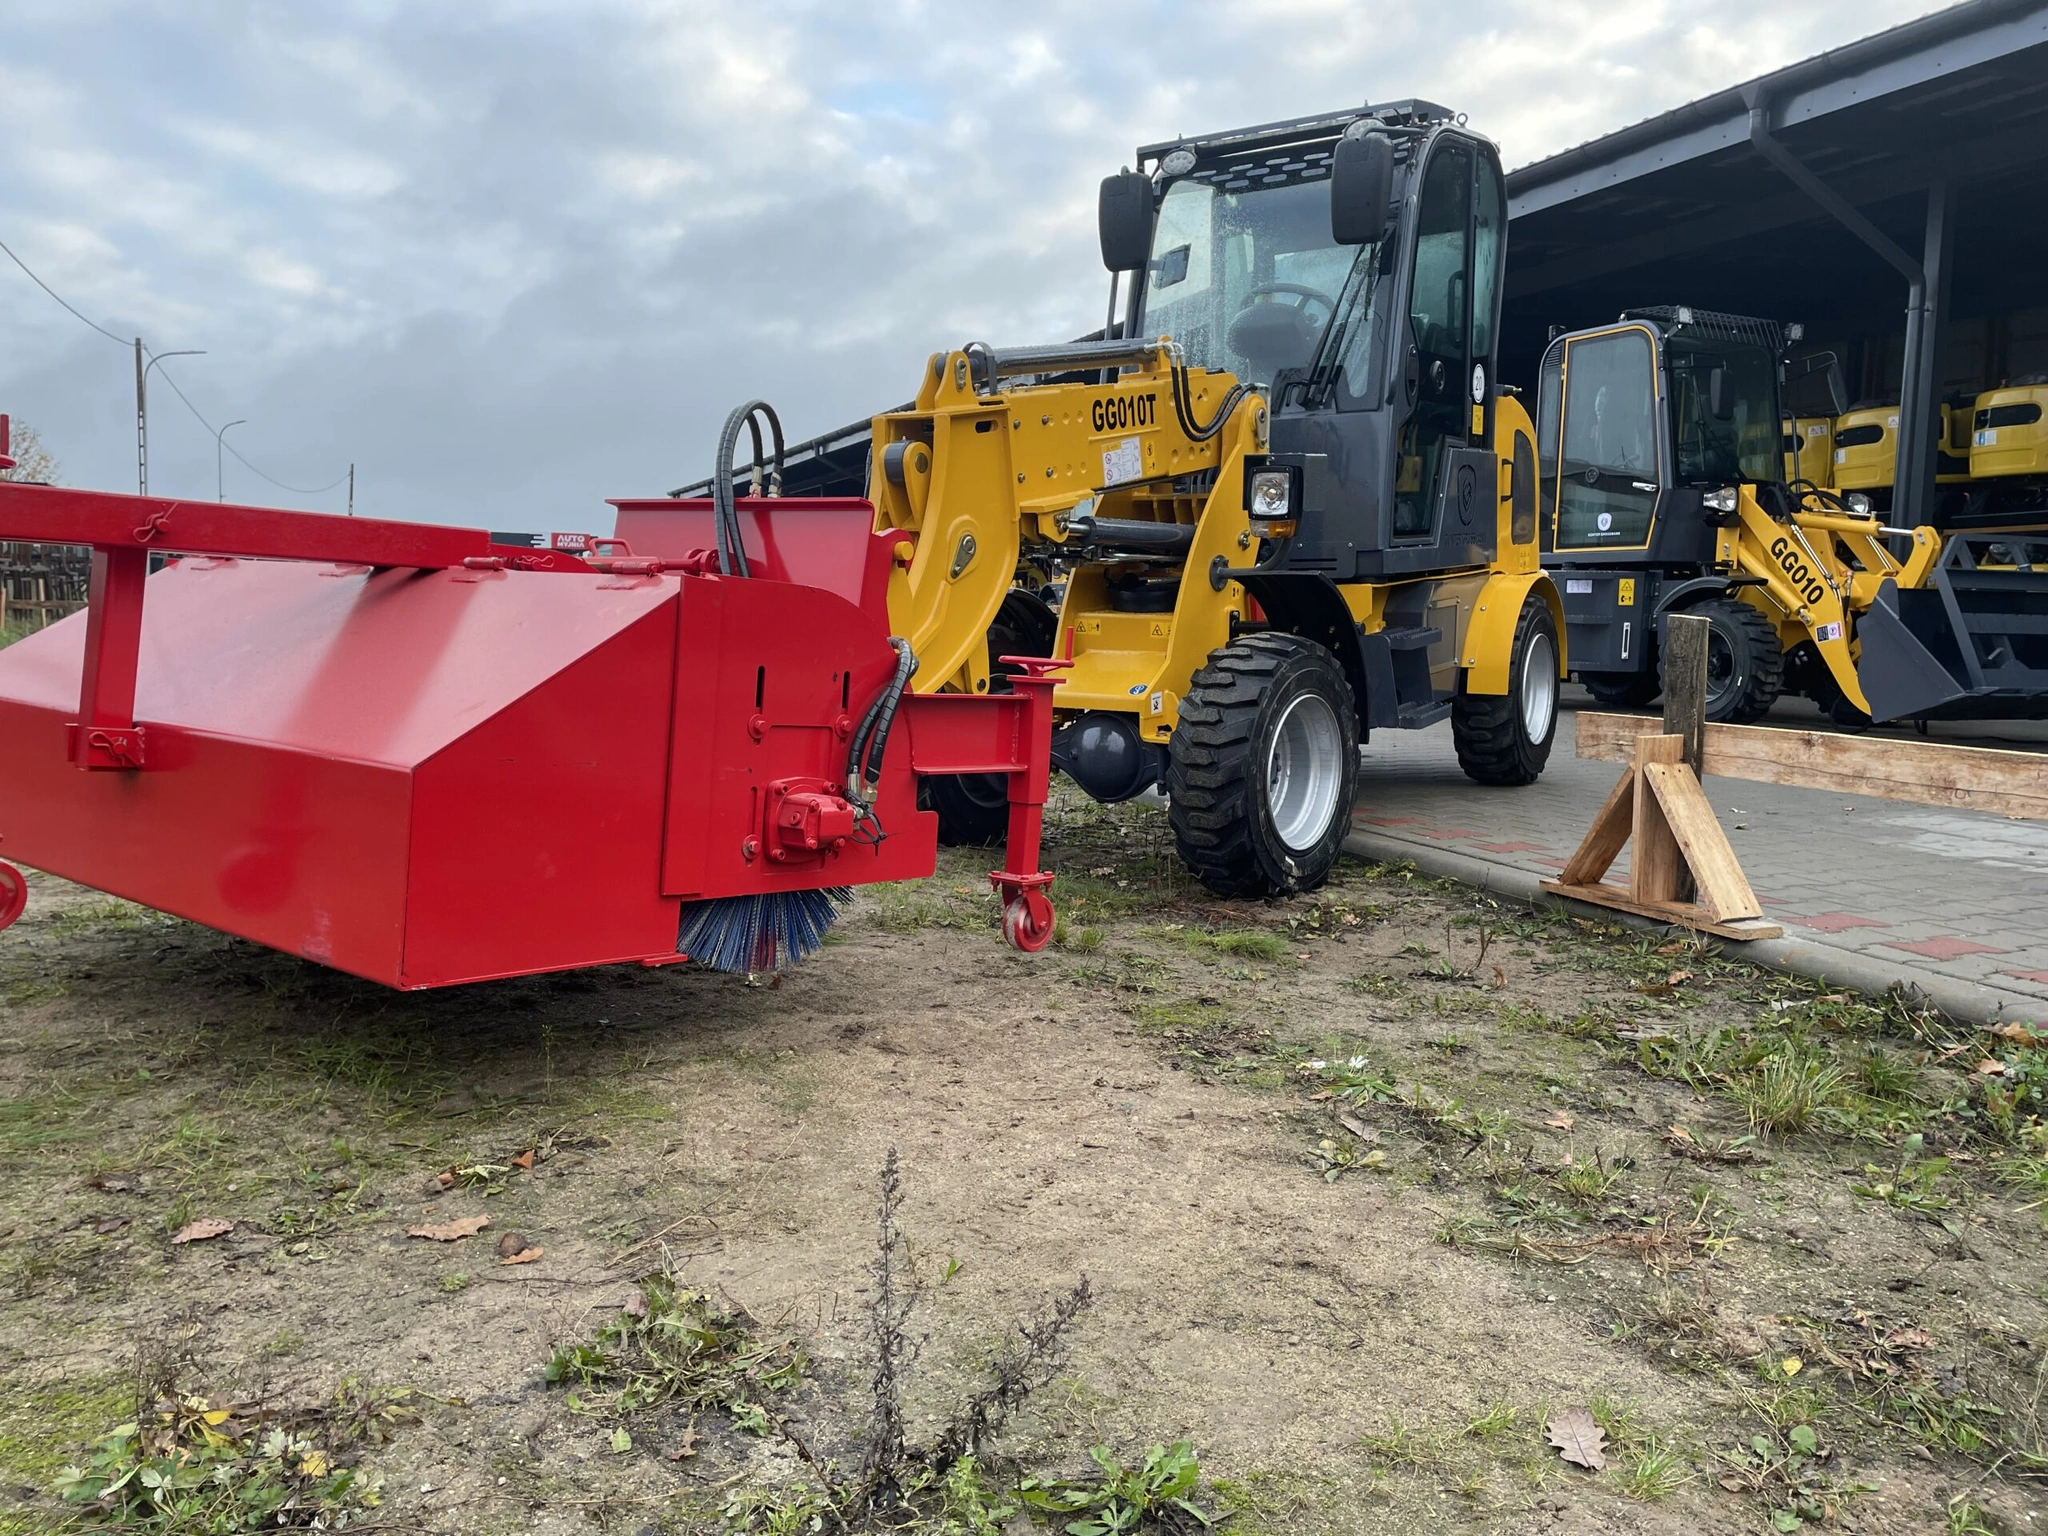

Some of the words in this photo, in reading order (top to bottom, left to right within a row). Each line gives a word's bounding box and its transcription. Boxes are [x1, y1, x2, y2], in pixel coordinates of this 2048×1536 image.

[1092, 393, 1156, 432] GG010T
[557, 534, 585, 542] AUTO
[1770, 537, 1824, 605] GG010
